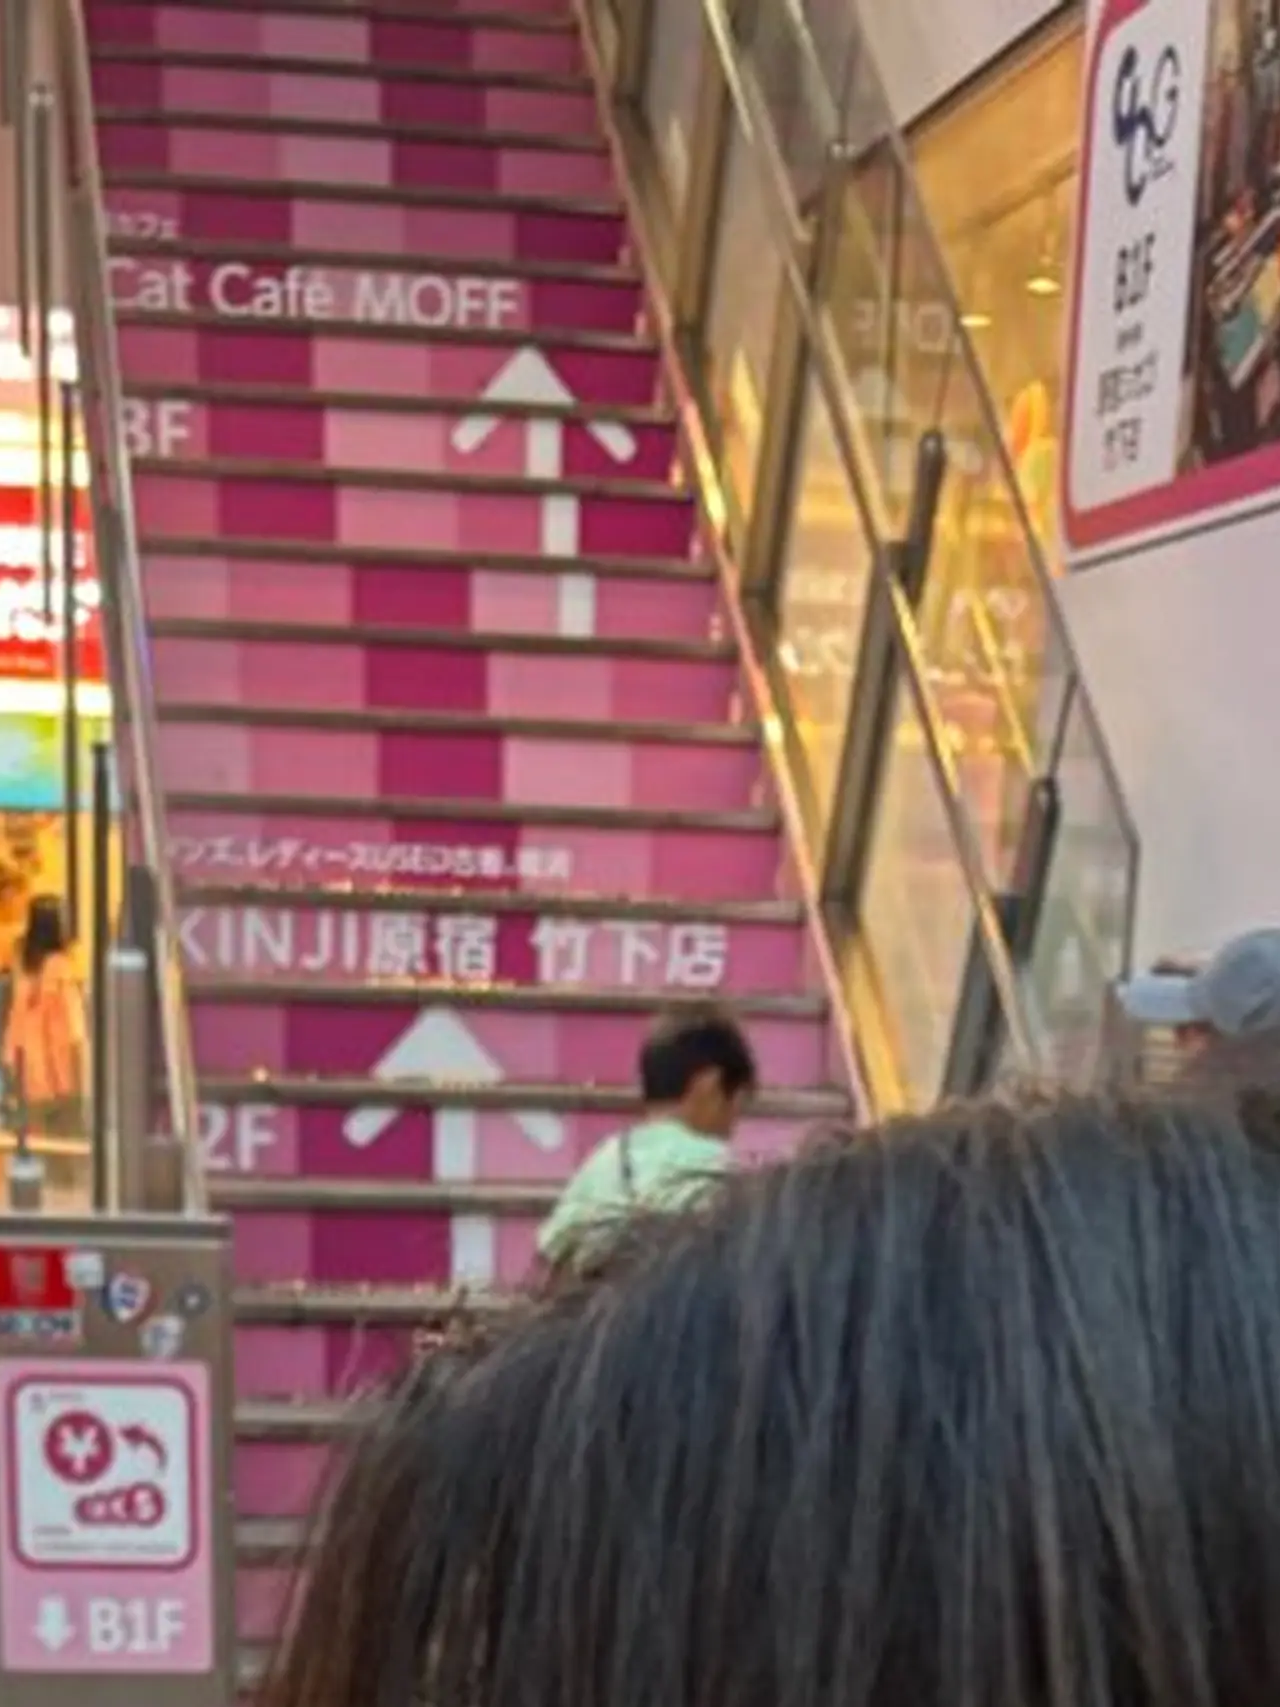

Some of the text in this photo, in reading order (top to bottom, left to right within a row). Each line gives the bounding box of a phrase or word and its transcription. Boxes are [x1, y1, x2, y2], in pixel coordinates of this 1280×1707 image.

[104, 256, 520, 329] Cat Café MOFF
[529, 911, 728, 987] 竹下店
[201, 1101, 277, 1173] 2F
[87, 1597, 185, 1655] B1F
